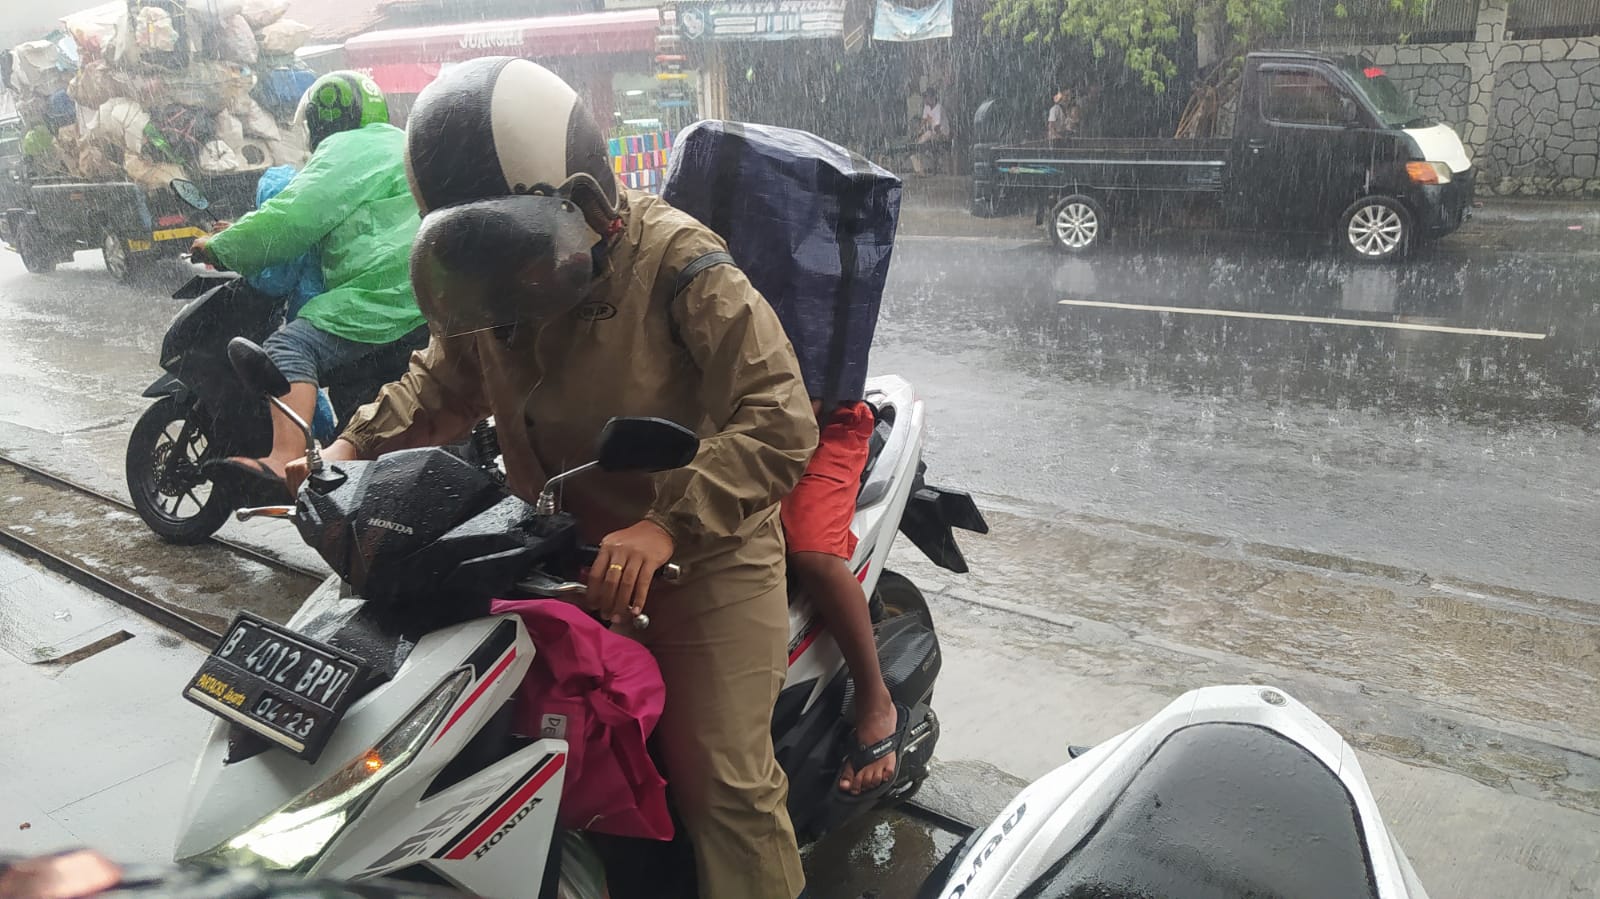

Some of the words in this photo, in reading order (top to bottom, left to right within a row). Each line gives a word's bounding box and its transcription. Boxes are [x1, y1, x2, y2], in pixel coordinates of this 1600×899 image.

[366, 517, 413, 535] HONDA
[220, 627, 247, 657] B
[245, 638, 300, 682] 4012
[295, 658, 349, 704] BPV
[473, 796, 544, 861] HONDA
